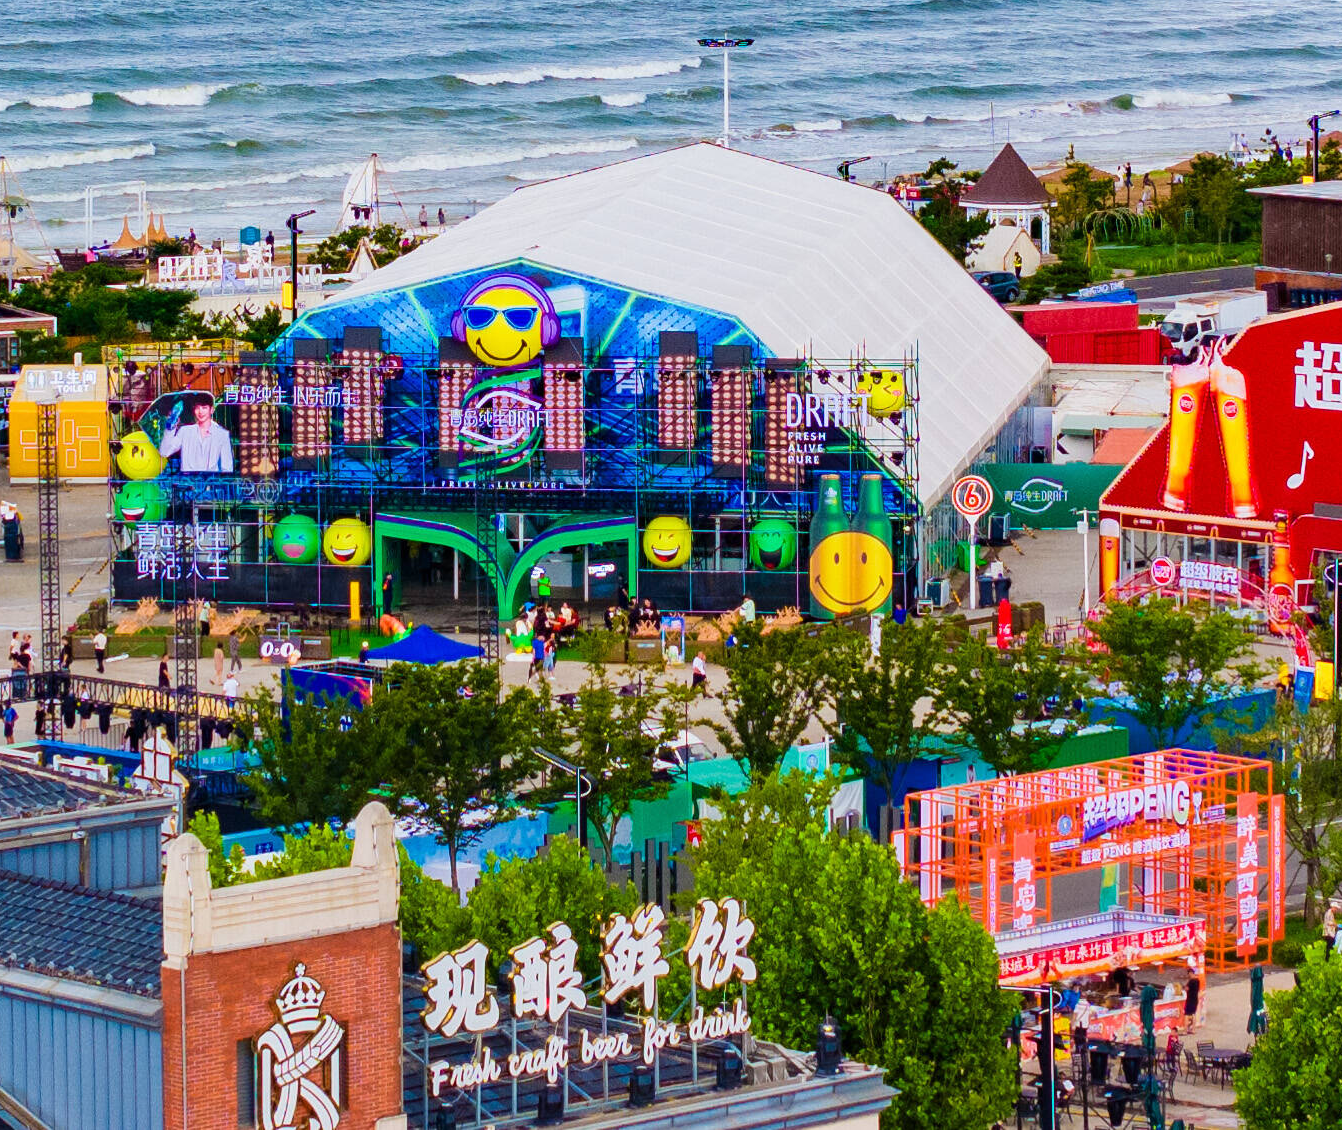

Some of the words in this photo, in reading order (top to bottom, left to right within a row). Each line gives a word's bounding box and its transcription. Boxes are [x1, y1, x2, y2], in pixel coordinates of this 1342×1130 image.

[49, 370, 97, 385] 卫生间
[58, 384, 89, 393] TOILET
[786, 392, 873, 428] DRAFT
[787, 431, 827, 441] FRESH
[787, 443, 826, 453] ALIVE
[787, 455, 820, 465] PURE
[964, 482, 982, 510] 6
[136, 551, 230, 581] 鲜活人生
[1102, 843, 1132, 859] PENG
[421, 896, 758, 1038] 现酿鲜饮
[429, 1047, 501, 1097] Fresh
[509, 1034, 569, 1084] craft
[581, 1028, 632, 1064] beer
[643, 1017, 680, 1064] for
[689, 998, 752, 1041] drink
